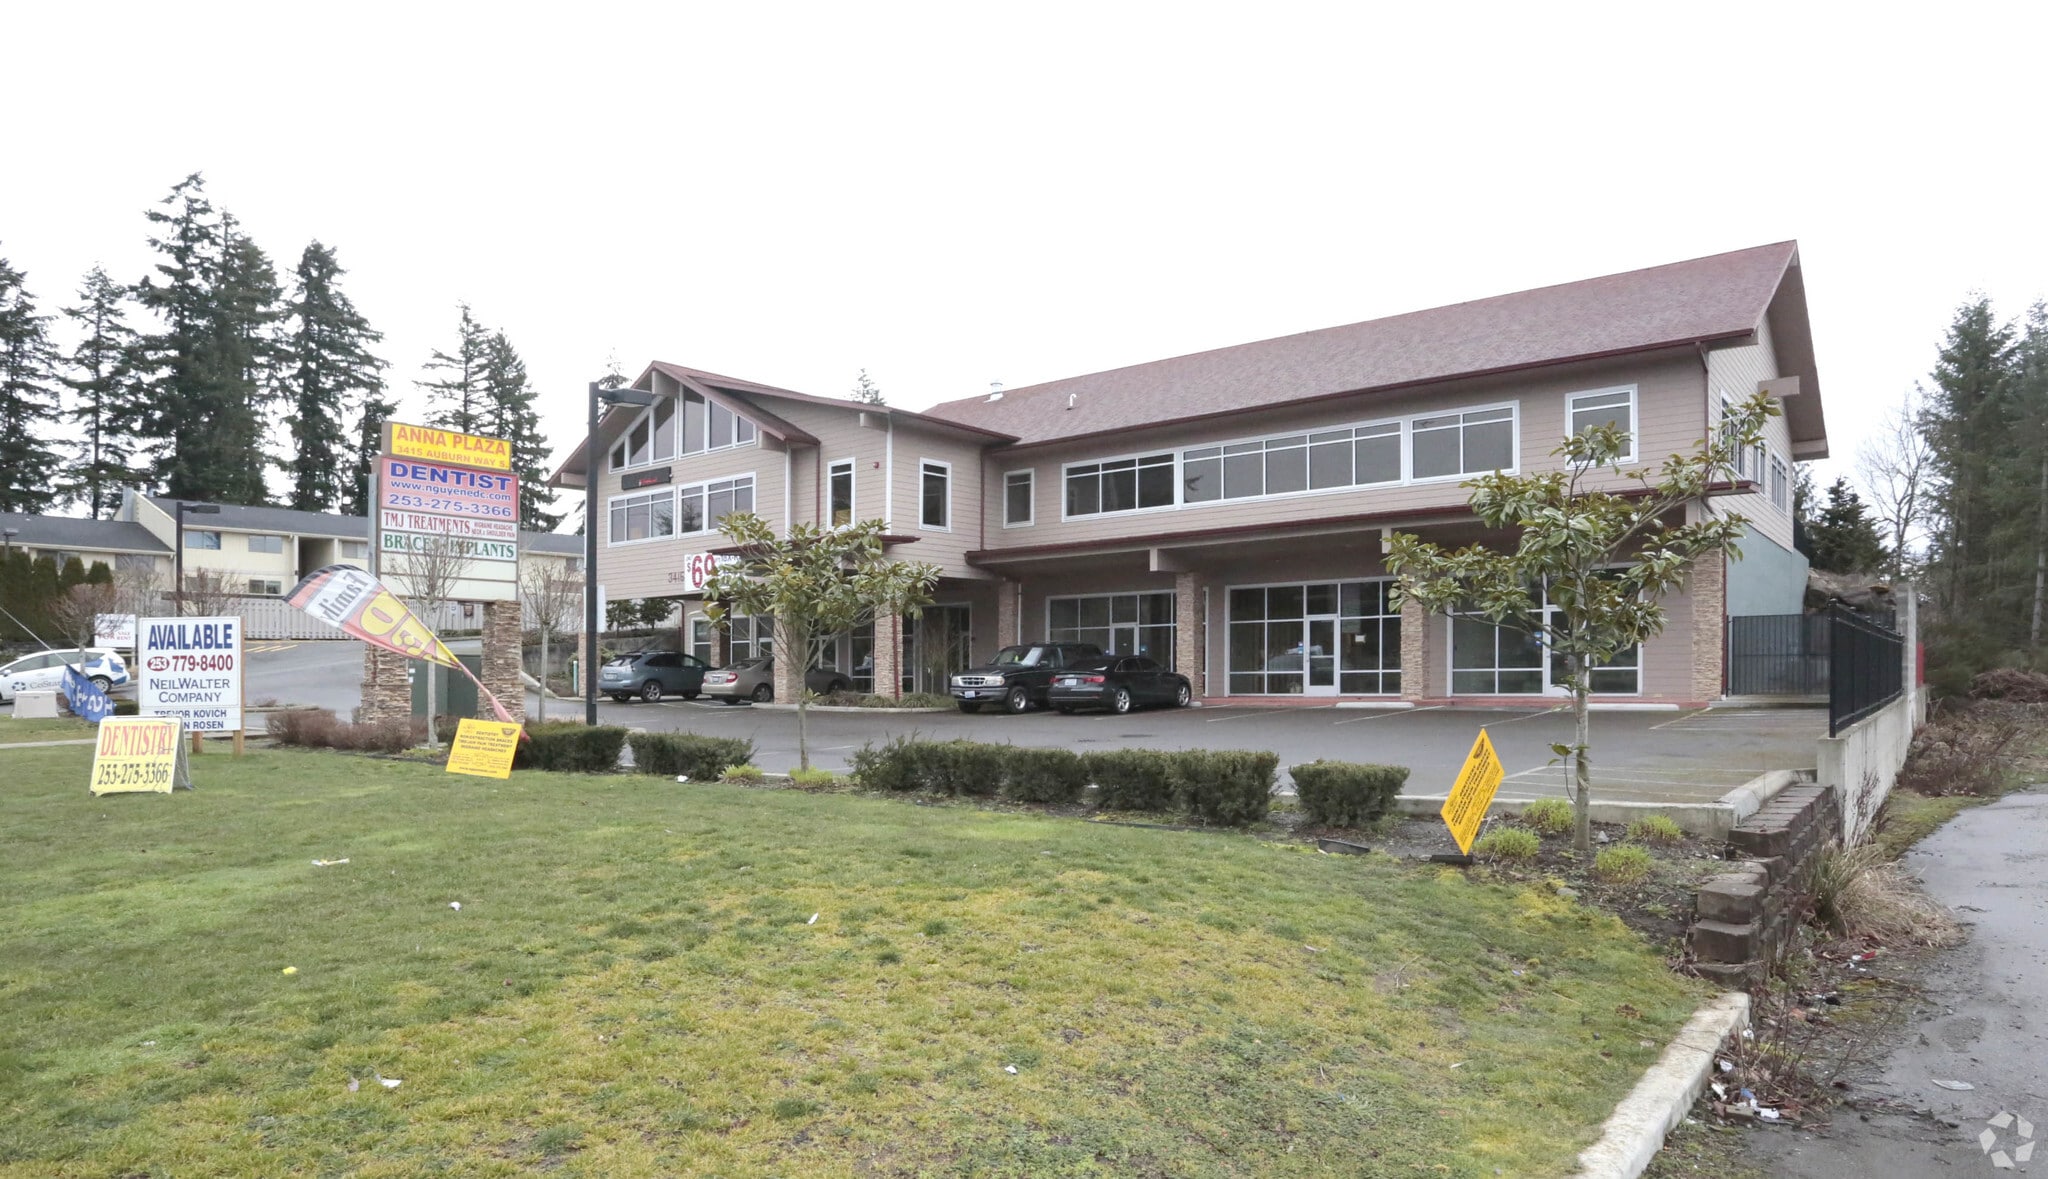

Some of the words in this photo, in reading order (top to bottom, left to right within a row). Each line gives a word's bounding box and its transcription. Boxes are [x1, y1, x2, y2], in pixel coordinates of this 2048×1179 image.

[397, 426, 447, 447] ANNA
[453, 434, 506, 456] PLAZA
[397, 445, 423, 457] 3415
[426, 449, 471, 462] AUBURN
[473, 456, 496, 466] WAY
[390, 462, 511, 491] DENTIST
[390, 480, 511, 502] www.nguyenedc.com
[388, 493, 511, 517] 253-275-3366
[383, 511, 405, 528] TMJ
[408, 514, 471, 536] TREATMENTS
[147, 623, 233, 650] AVAILABLE
[158, 691, 222, 703] COMPANY
[192, 720, 224, 730] ROSEN
[193, 709, 227, 718] KOVICH
[100, 724, 176, 757] DENTISTRY
[97, 762, 170, 785] 253-275-3366
